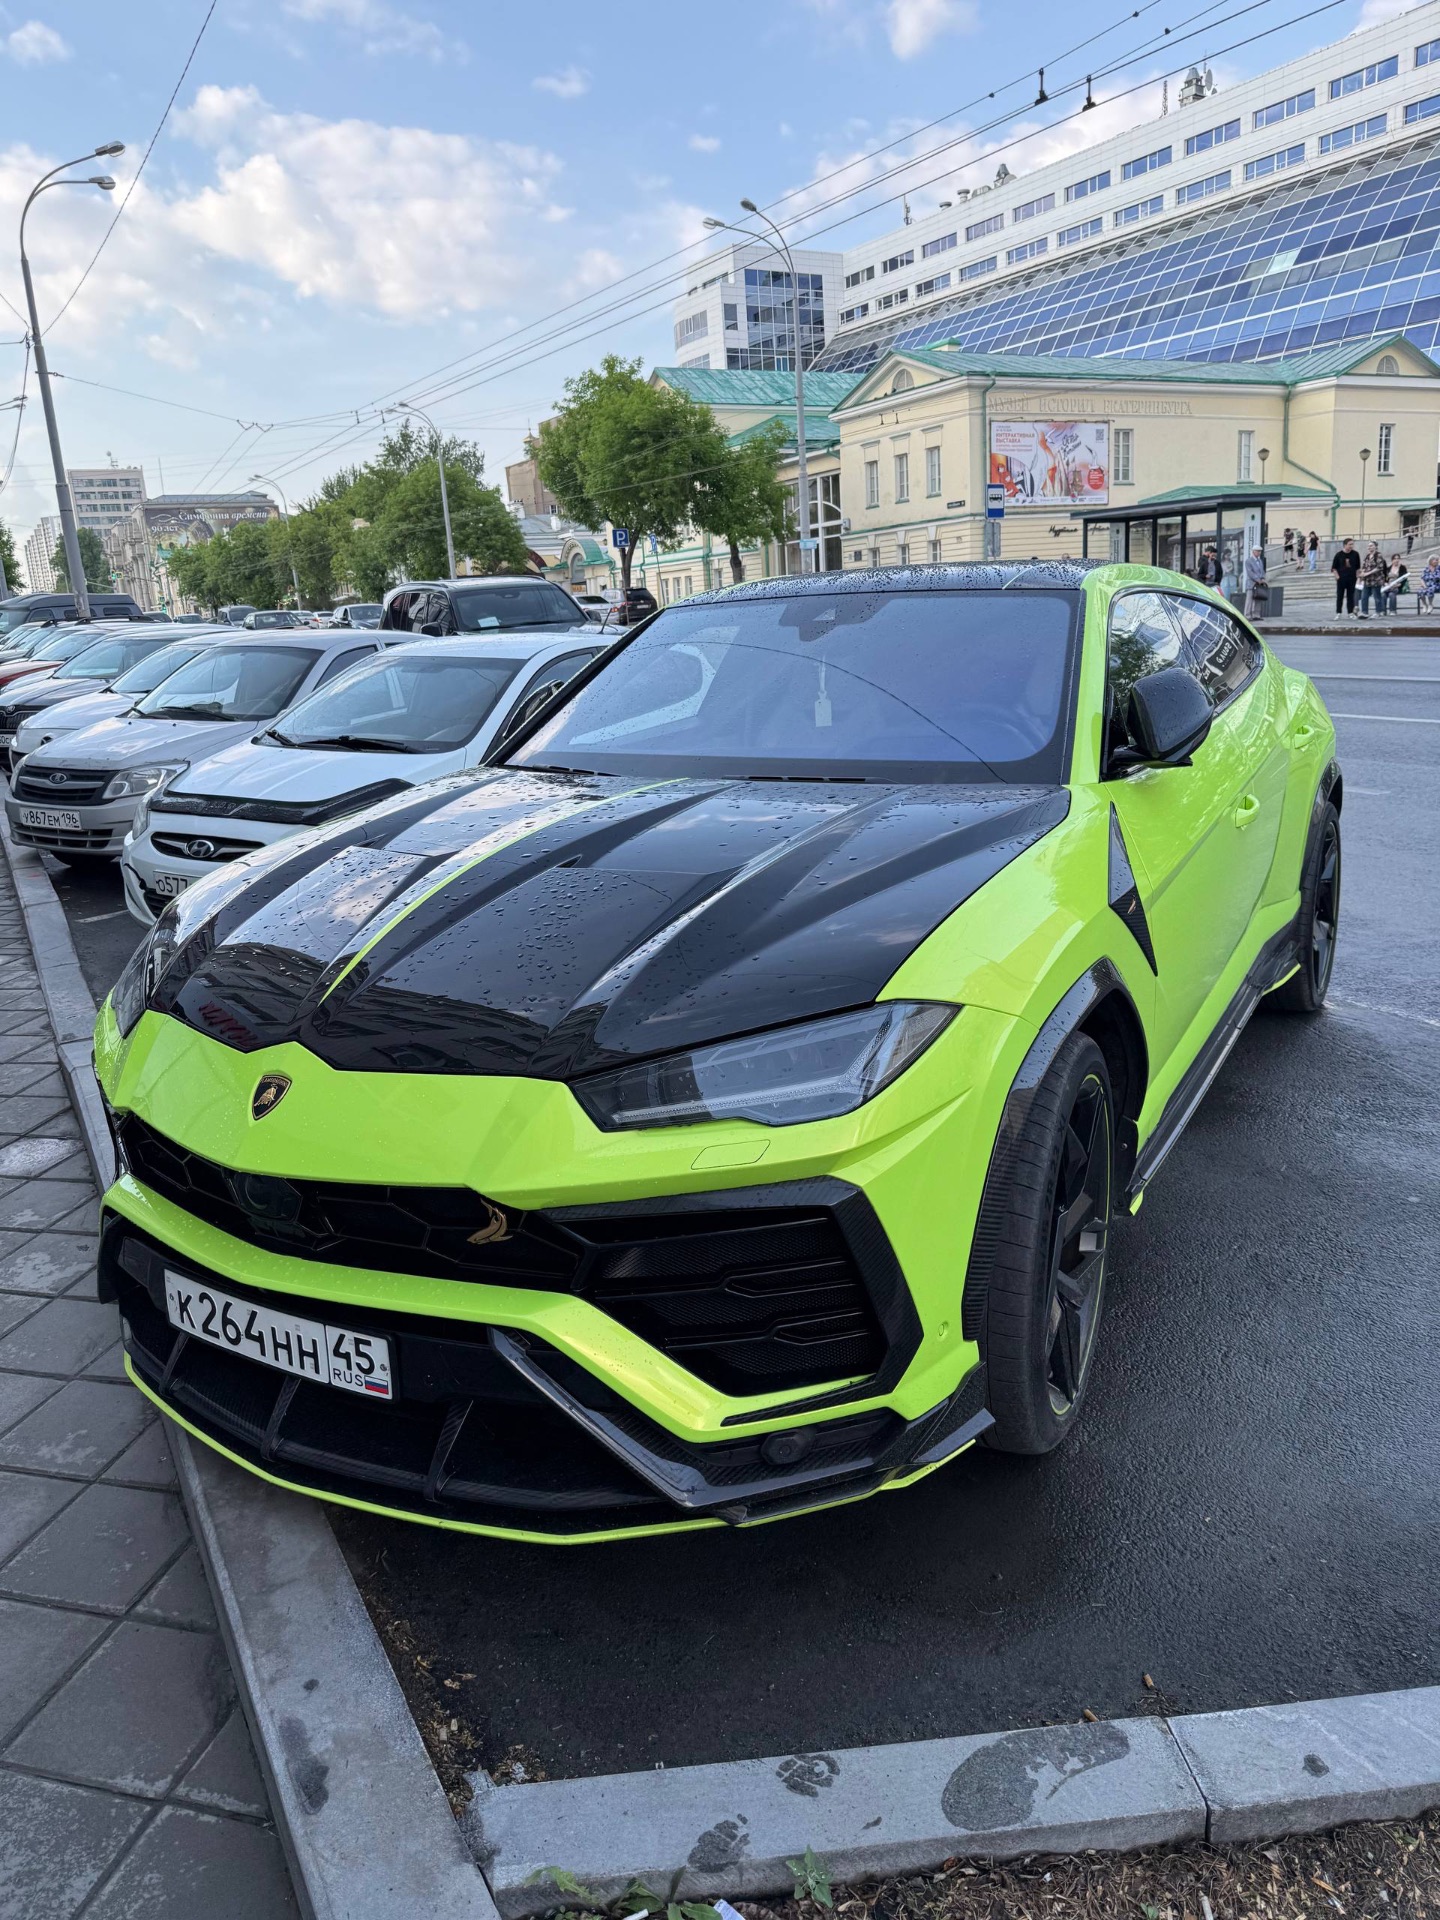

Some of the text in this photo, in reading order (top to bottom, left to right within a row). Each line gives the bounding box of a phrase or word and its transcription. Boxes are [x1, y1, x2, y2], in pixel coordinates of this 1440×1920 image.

[988, 397, 1031, 412] МУЗЕЙ
[1103, 399, 1193, 415] ЕКАТЕРИНБУРГА
[178, 511, 268, 522] Симфония времени
[151, 525, 163, 534] 90
[616, 530, 626, 546] P
[61, 812, 78, 824] 196
[176, 1289, 375, 1375] К264НН 45
[332, 1367, 364, 1387] RUS
